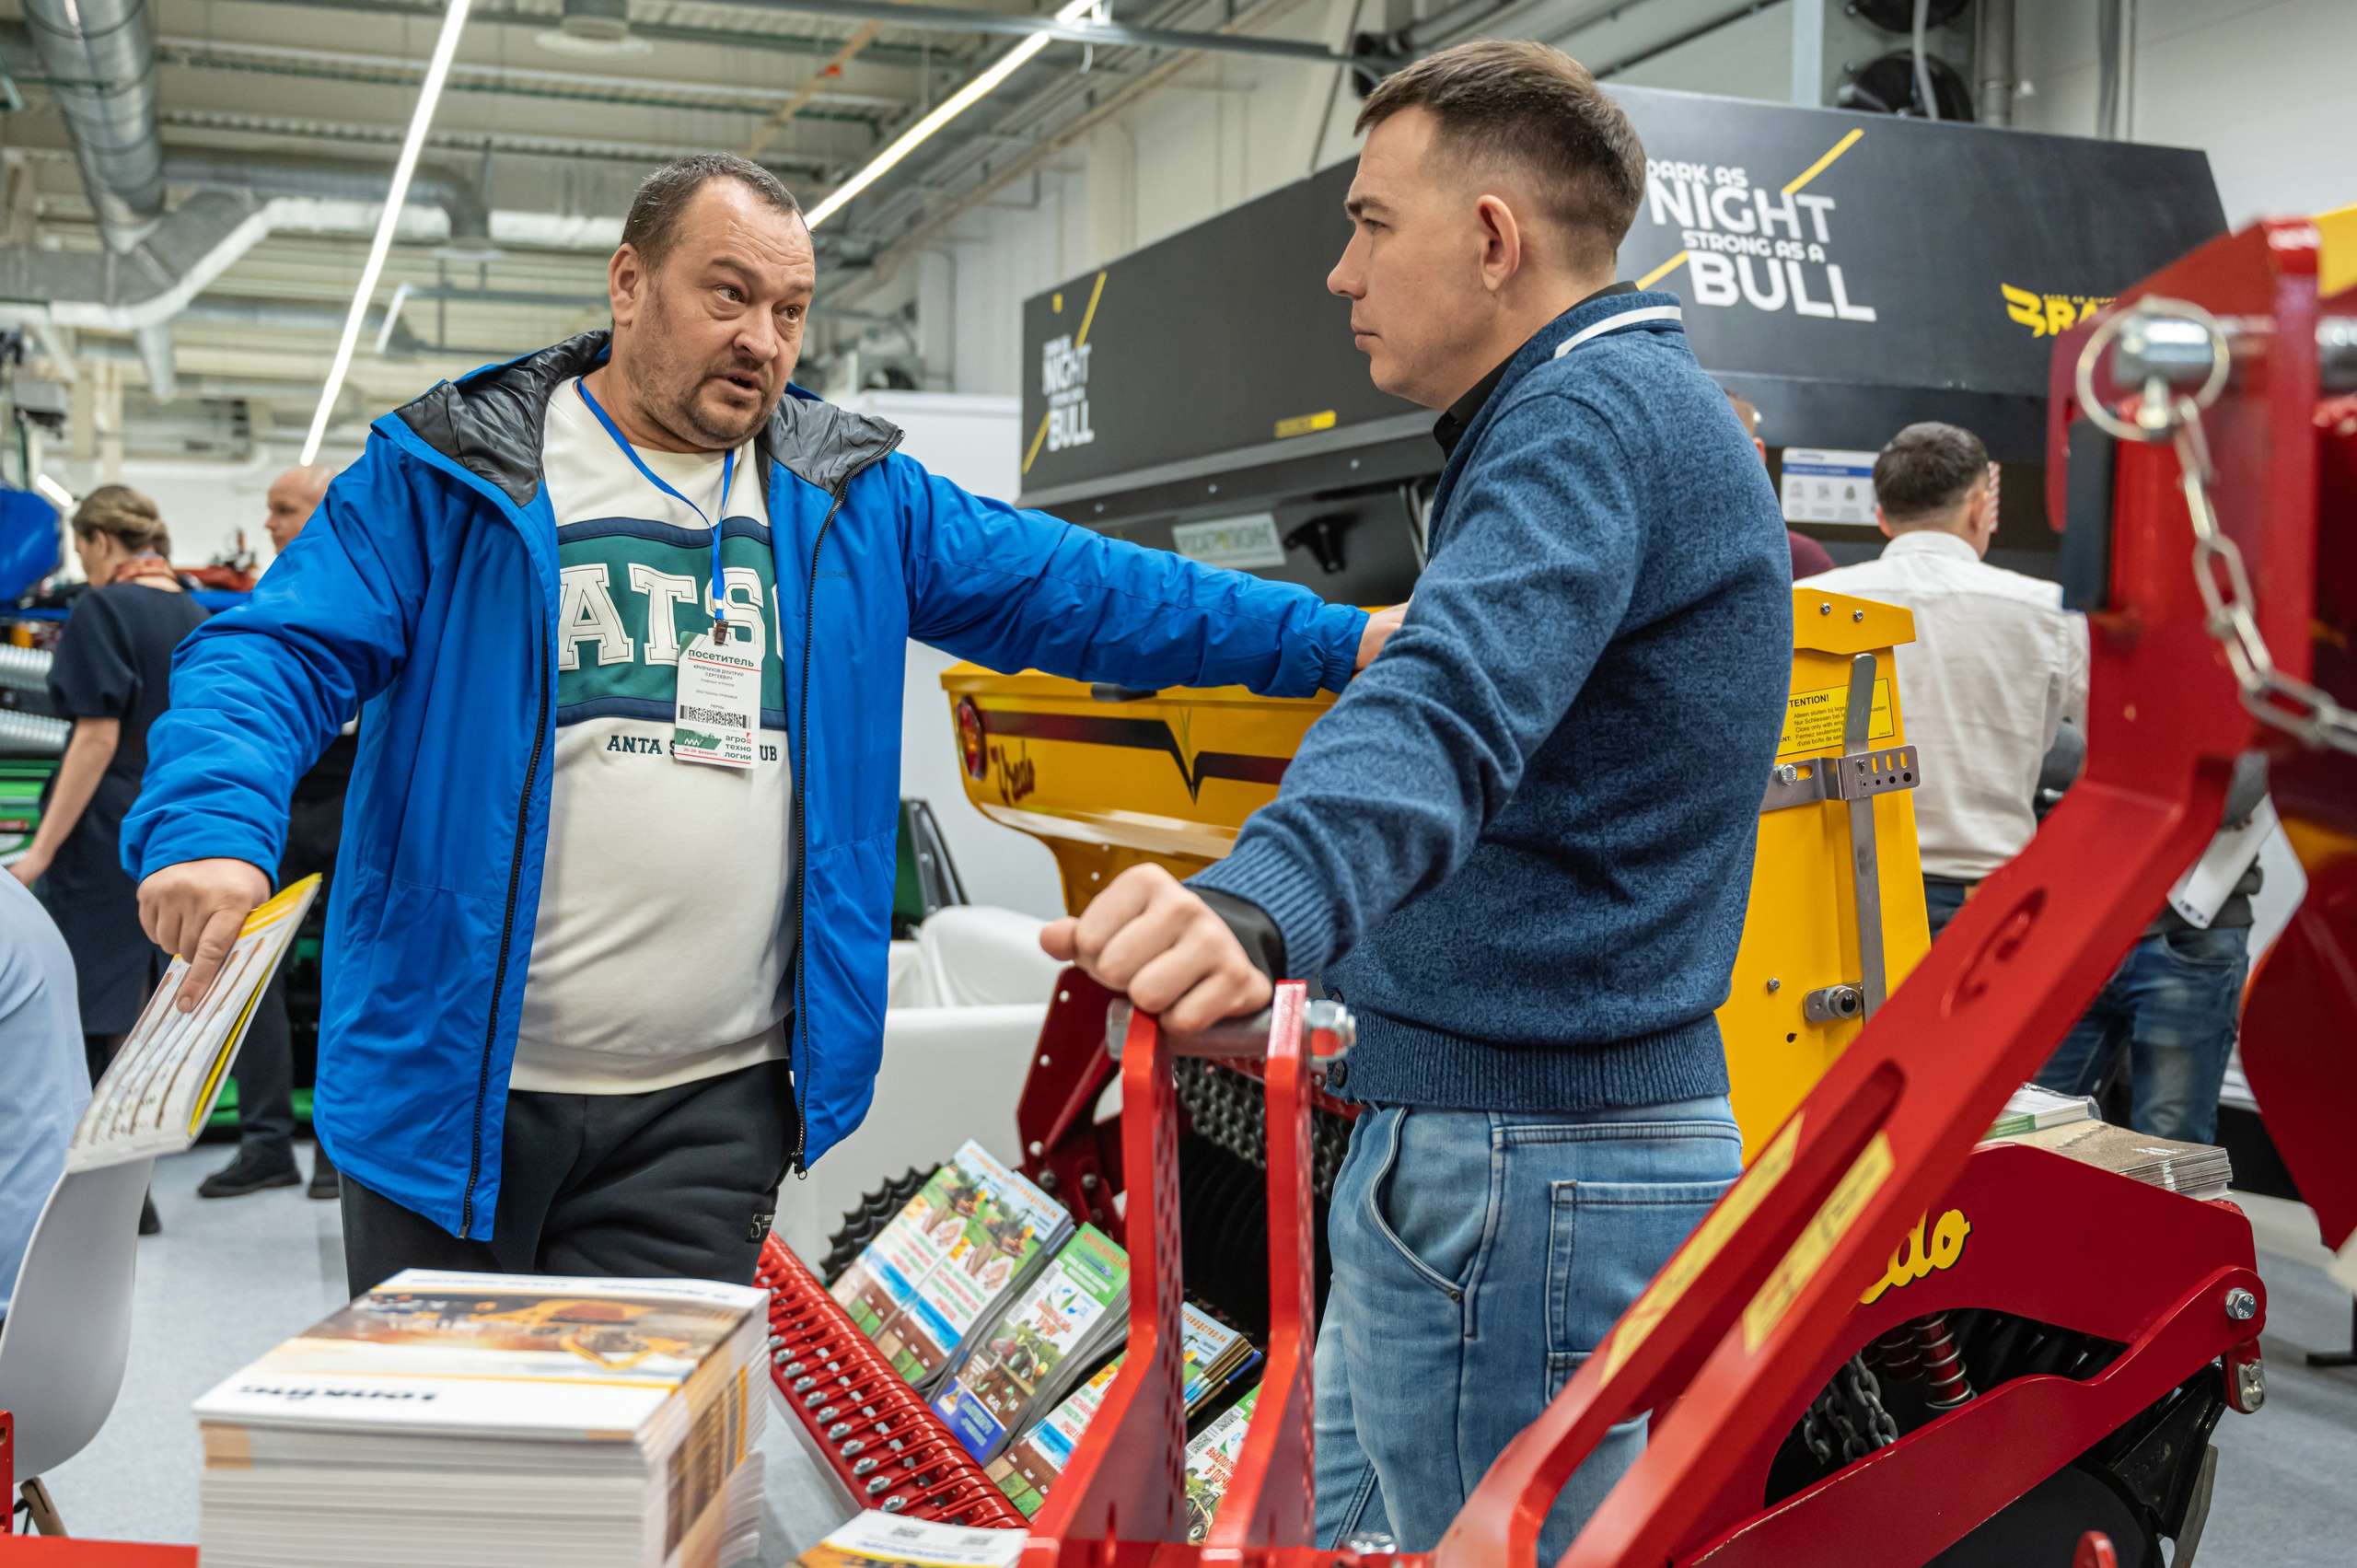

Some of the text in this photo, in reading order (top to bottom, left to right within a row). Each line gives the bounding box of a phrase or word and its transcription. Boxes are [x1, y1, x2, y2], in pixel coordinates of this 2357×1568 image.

[1646, 158, 1748, 188] DARK AS
[1646, 179, 1836, 243] NIGHT
[1681, 229, 1826, 263] STRONG AS A
[1688, 250, 1876, 322] BULL
[1047, 399, 1095, 451] BULL
[688, 649, 755, 668] посетитель
[704, 672, 733, 680] СЕРГЕЕВИЧ
[1789, 693, 1829, 708] TENTION!
[1794, 709, 1810, 719] Alleen
[1810, 706, 1827, 716] sluiten
[1805, 714, 1832, 726] Schliessen
[1795, 732, 1816, 740] Fermez
[1816, 727, 1842, 738] seulement
[1810, 723, 1822, 732] only
[607, 735, 663, 755] ANTA
[726, 735, 746, 744] агро
[726, 743, 752, 752] техно
[724, 751, 751, 761] логии
